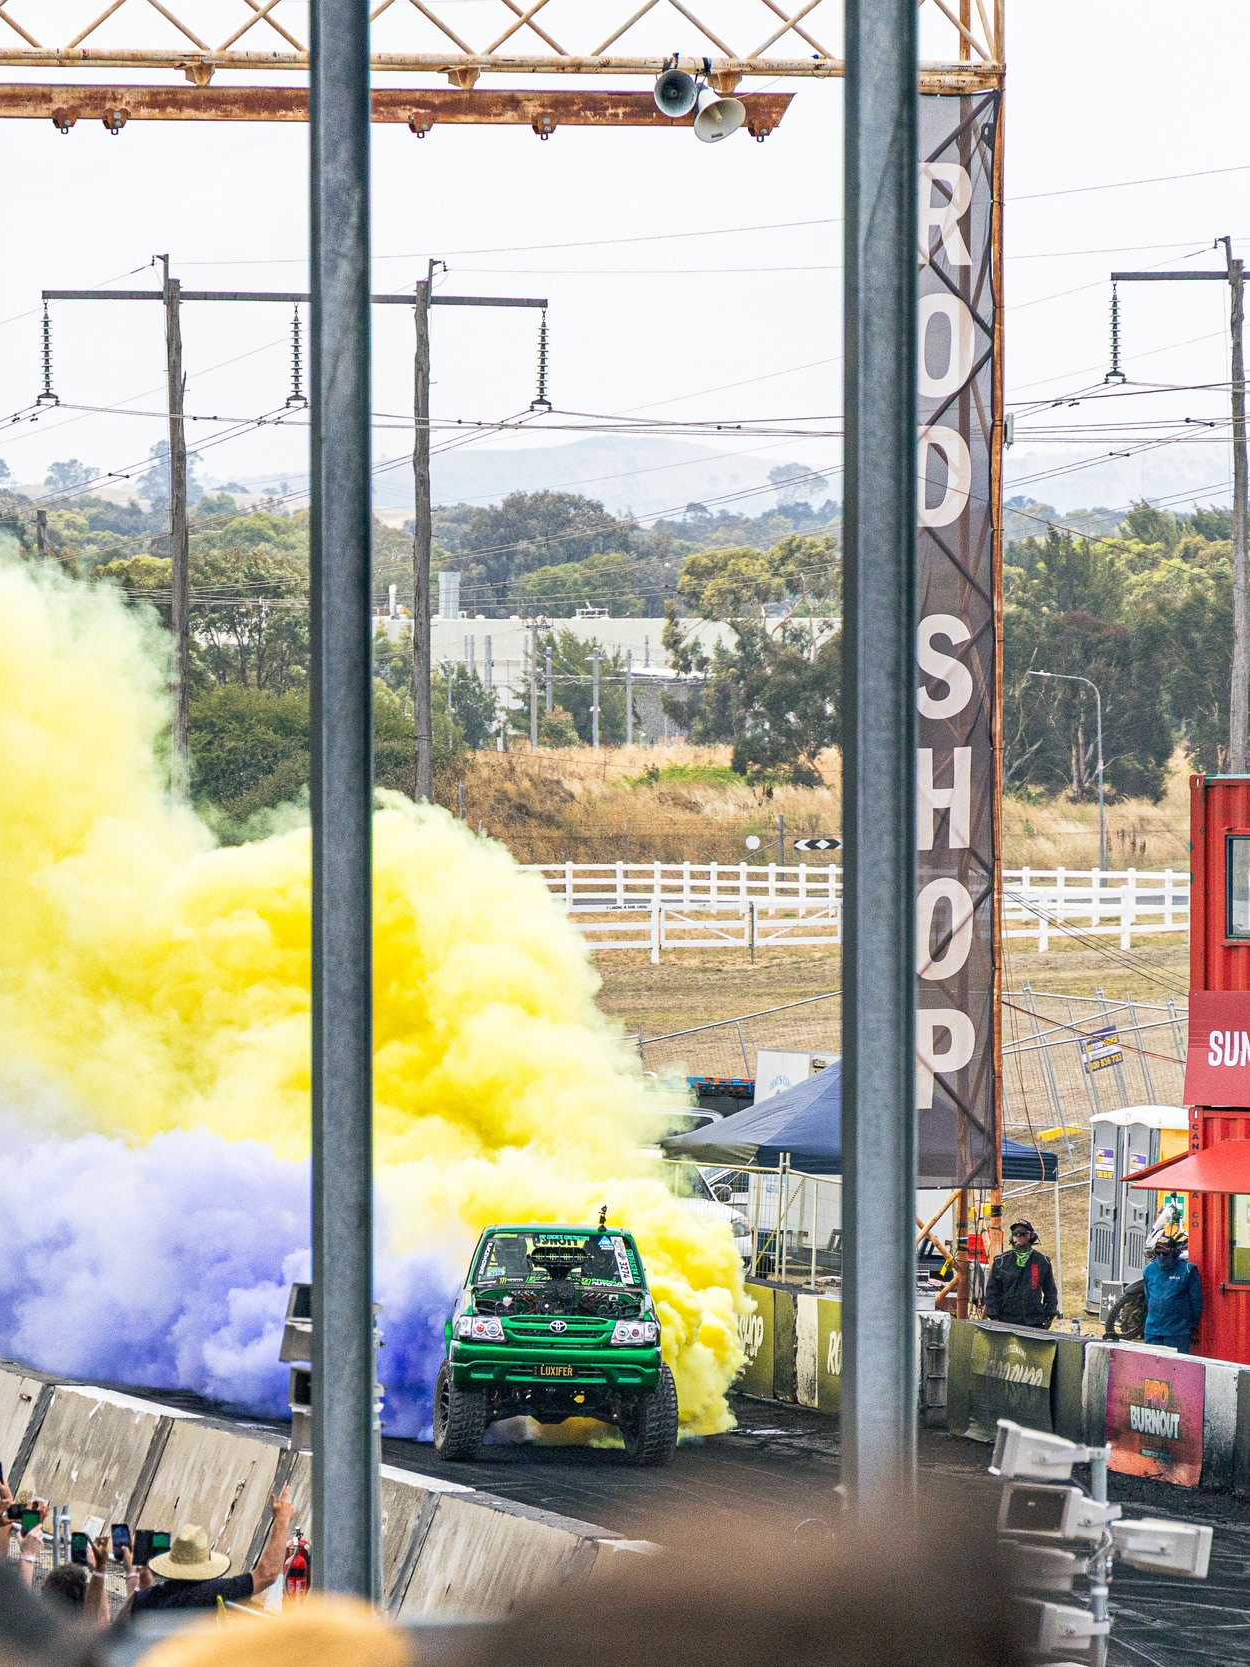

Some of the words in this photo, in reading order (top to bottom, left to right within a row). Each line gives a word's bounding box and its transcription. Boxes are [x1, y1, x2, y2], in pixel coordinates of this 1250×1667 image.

[918, 162, 975, 528] ROD
[917, 613, 976, 1110] SHOP
[540, 1366, 573, 1377] LUXIFER
[1143, 1378, 1169, 1411] PRO
[1130, 1405, 1181, 1439] BURNOUT
